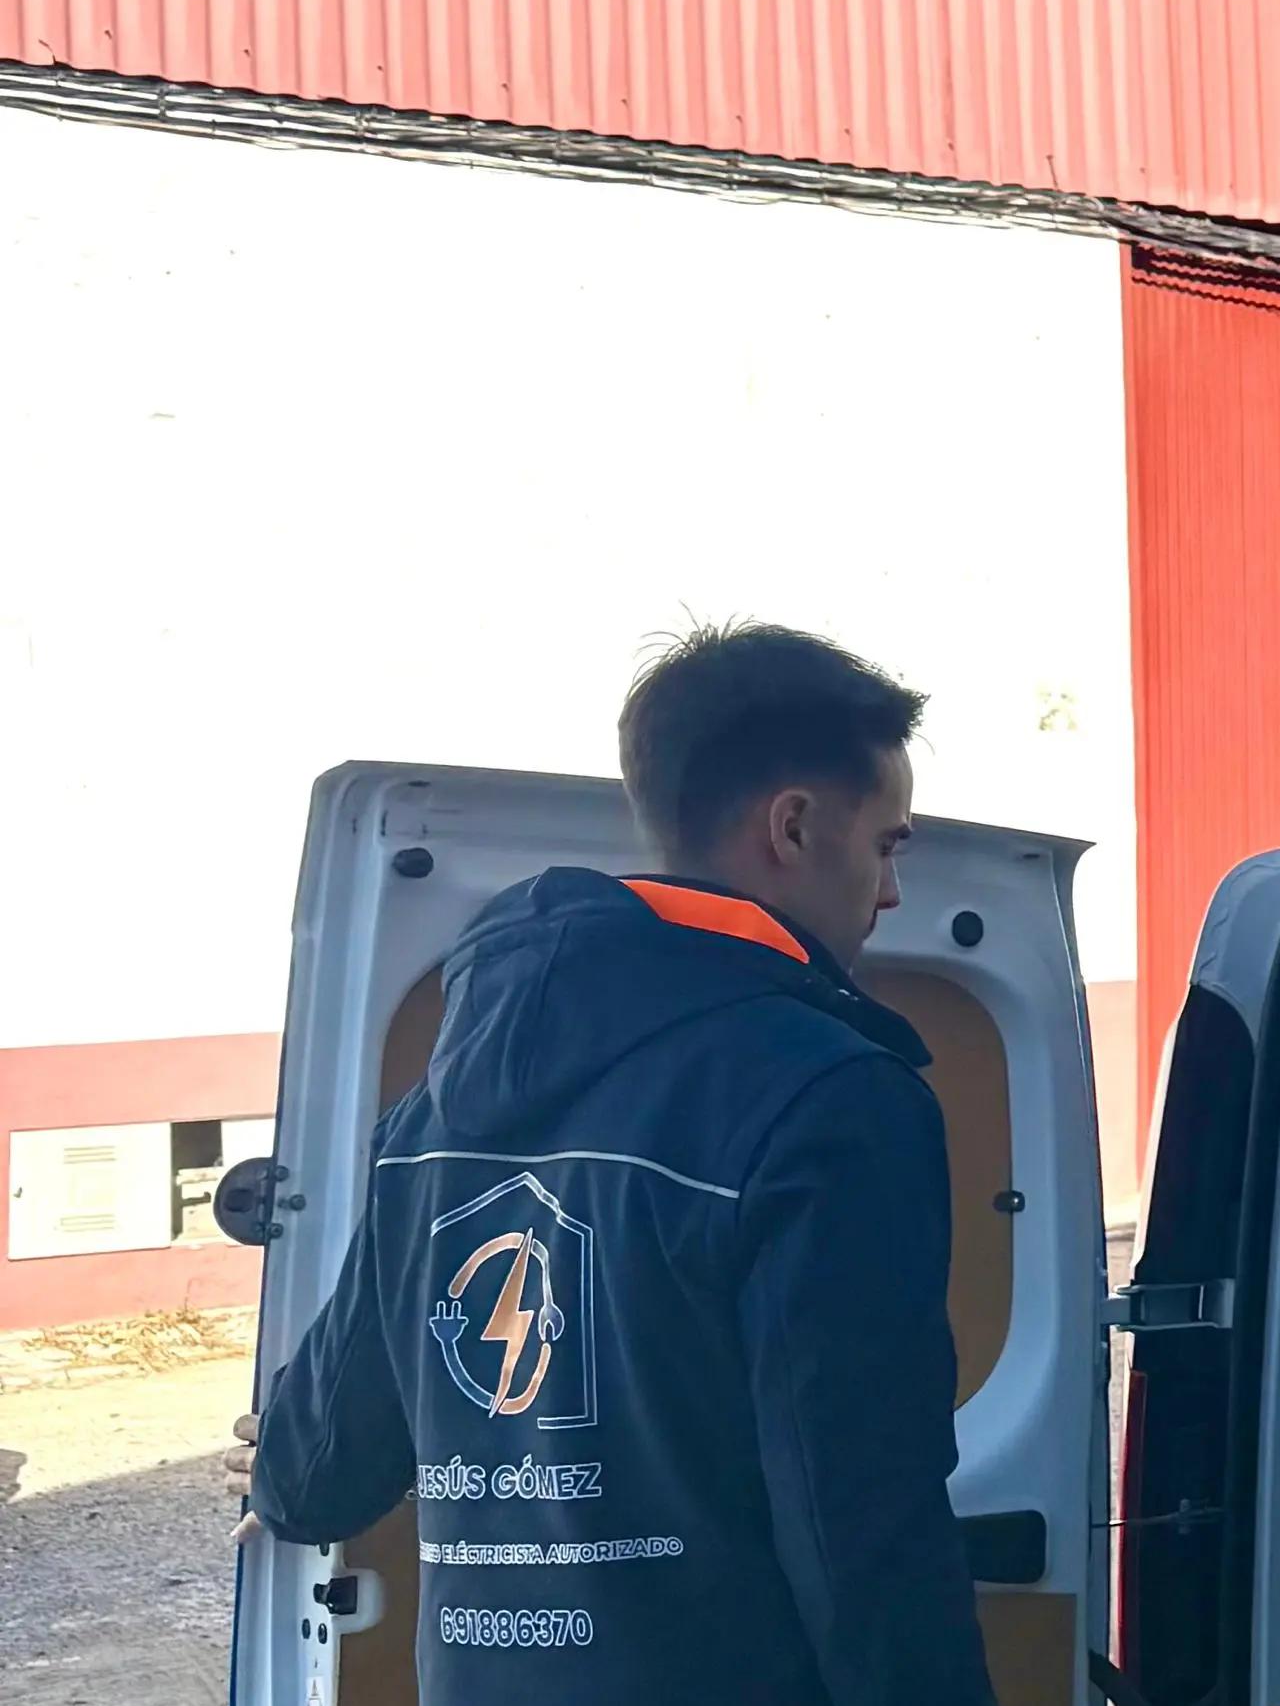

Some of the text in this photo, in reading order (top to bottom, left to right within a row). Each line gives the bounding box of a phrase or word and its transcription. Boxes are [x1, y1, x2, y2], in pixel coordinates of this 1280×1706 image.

[418, 1453, 602, 1501] JESÚS GÓMEZ
[545, 1536, 684, 1565] AUTORIZADO
[440, 1606, 594, 1647] 691886370
